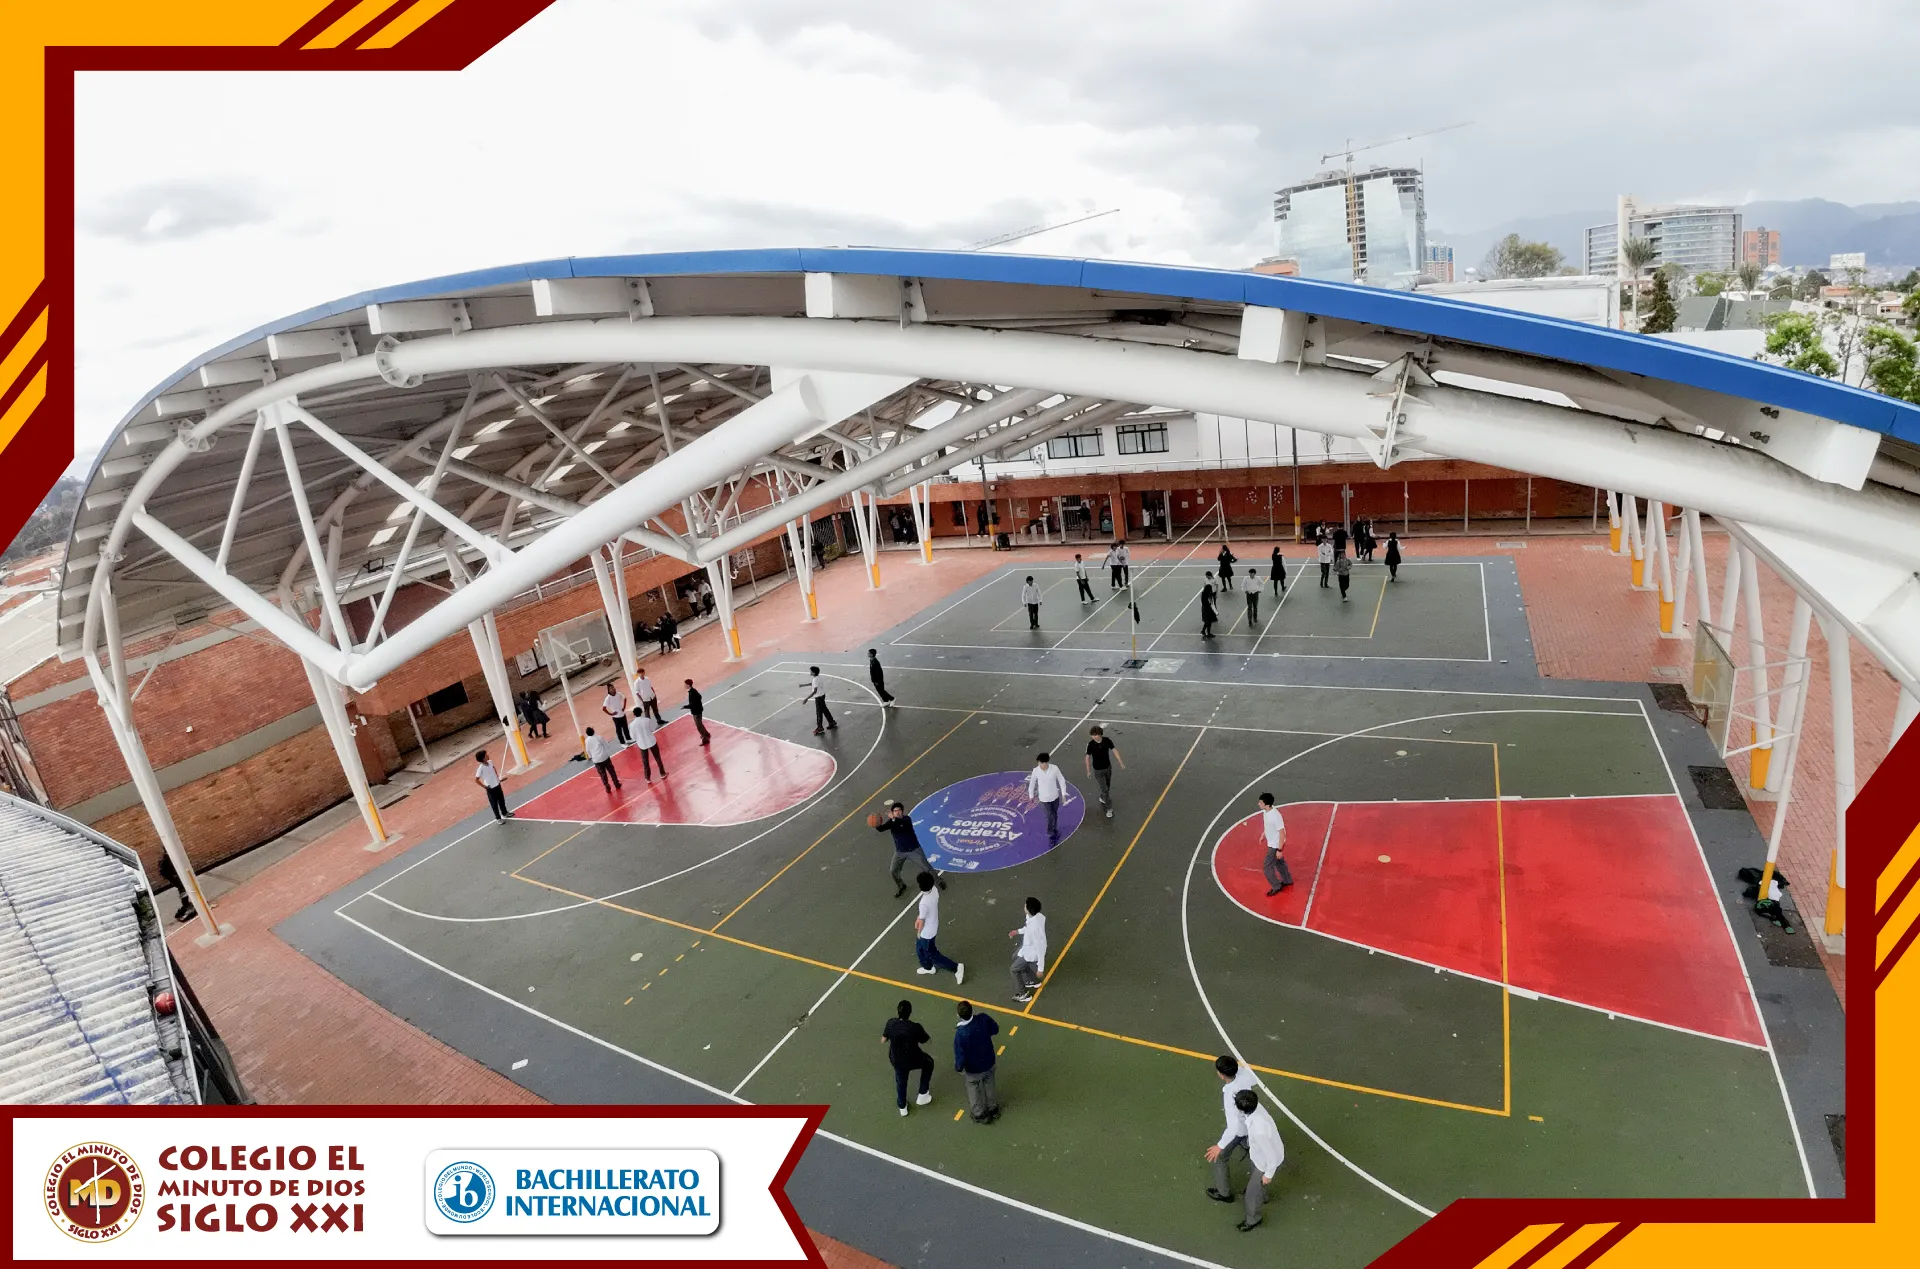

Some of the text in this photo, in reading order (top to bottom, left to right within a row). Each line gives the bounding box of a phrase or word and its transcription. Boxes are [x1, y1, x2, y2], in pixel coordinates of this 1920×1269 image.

[952, 819, 1014, 831] Sueños
[929, 825, 1023, 841] Atrapando
[974, 842, 1001, 853] Desde
